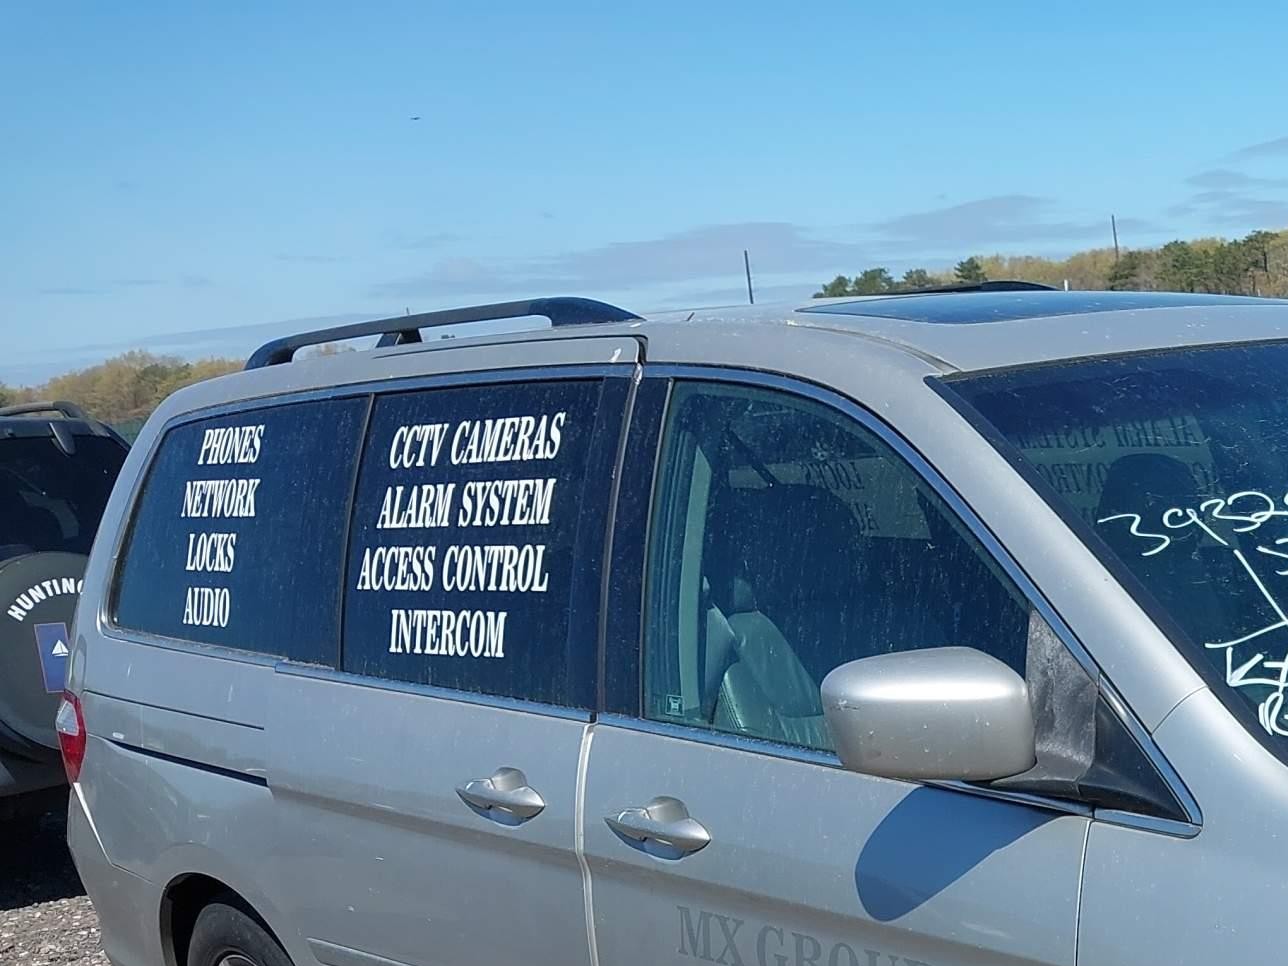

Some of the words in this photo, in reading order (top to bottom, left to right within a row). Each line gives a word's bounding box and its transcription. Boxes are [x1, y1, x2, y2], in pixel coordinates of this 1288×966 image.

[198, 425, 264, 465] PHONES
[390, 424, 448, 468] CCTV
[451, 413, 565, 464] CAMERAS
[181, 479, 260, 518] NETWORK
[377, 484, 455, 528] ALARM
[458, 479, 556, 526] SYSTEM
[186, 533, 236, 572] LOCKS
[357, 546, 435, 591] ACCESS
[443, 545, 548, 592] CONTROL
[183, 588, 230, 627] AUDIO
[389, 610, 507, 658] INTERCOM
